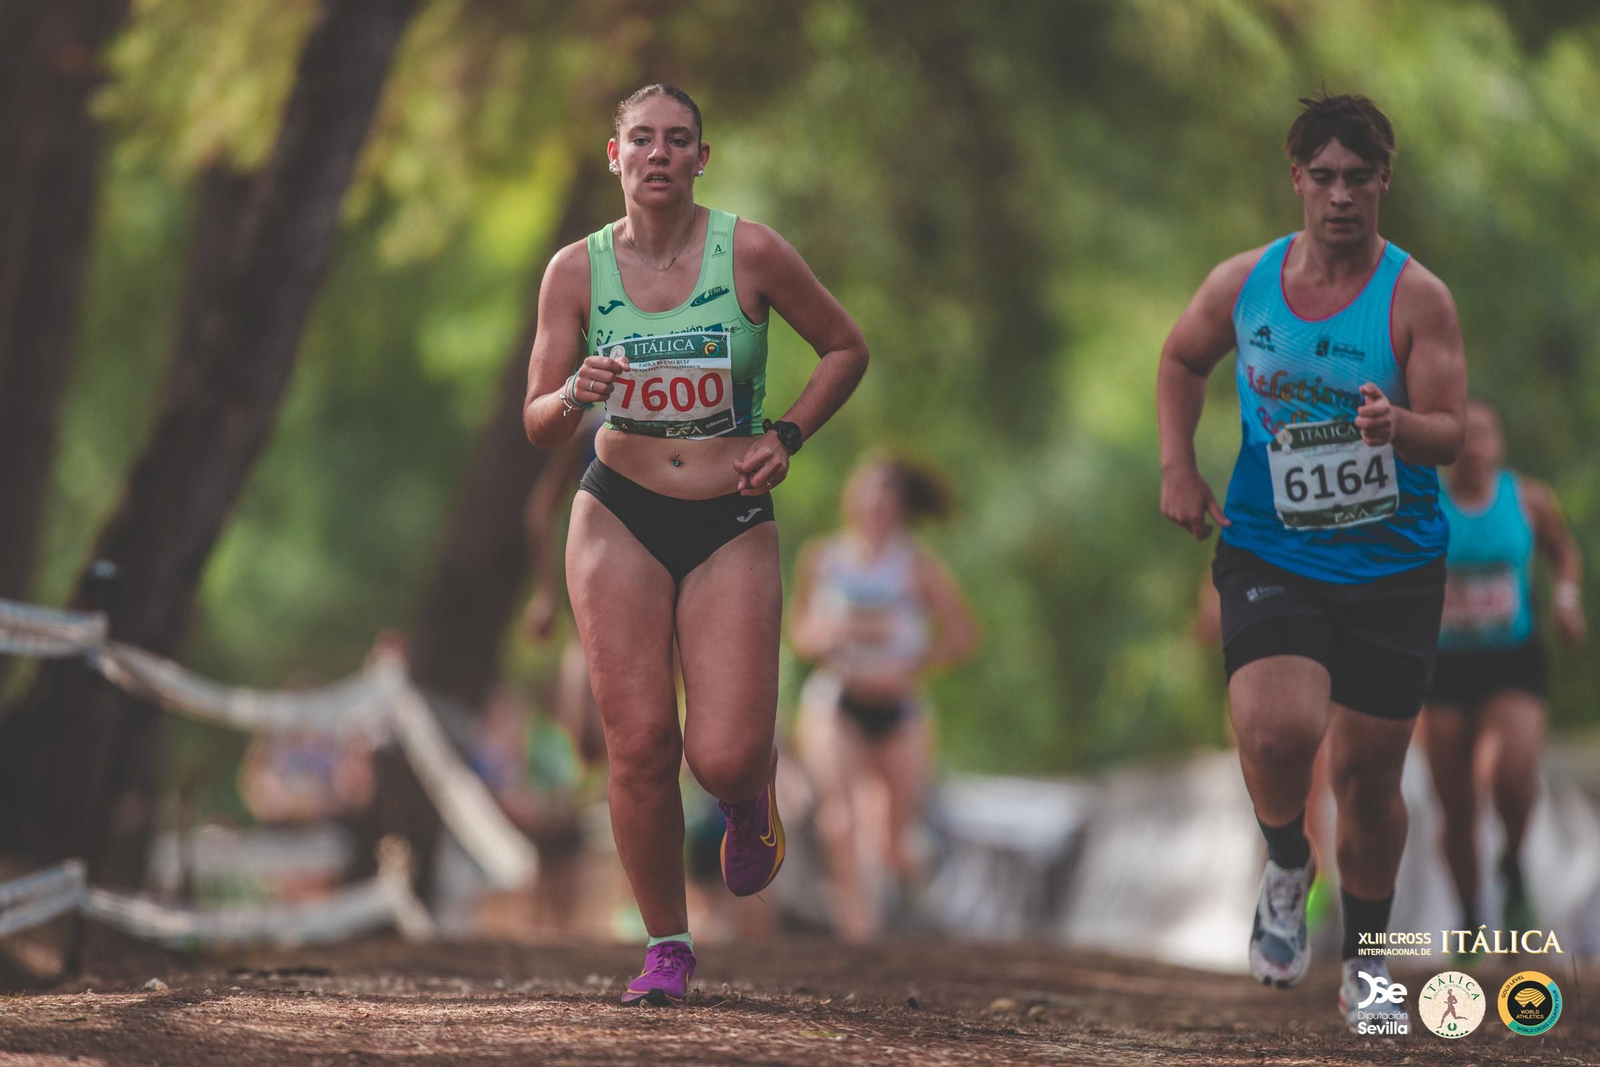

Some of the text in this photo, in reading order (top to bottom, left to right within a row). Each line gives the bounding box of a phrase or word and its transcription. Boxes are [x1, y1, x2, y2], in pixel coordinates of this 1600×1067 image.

[634, 338, 695, 356] ITÁLICA
[615, 372, 724, 412] 7600
[1299, 423, 1357, 442] ITÁLICA
[1284, 454, 1389, 503] 6164
